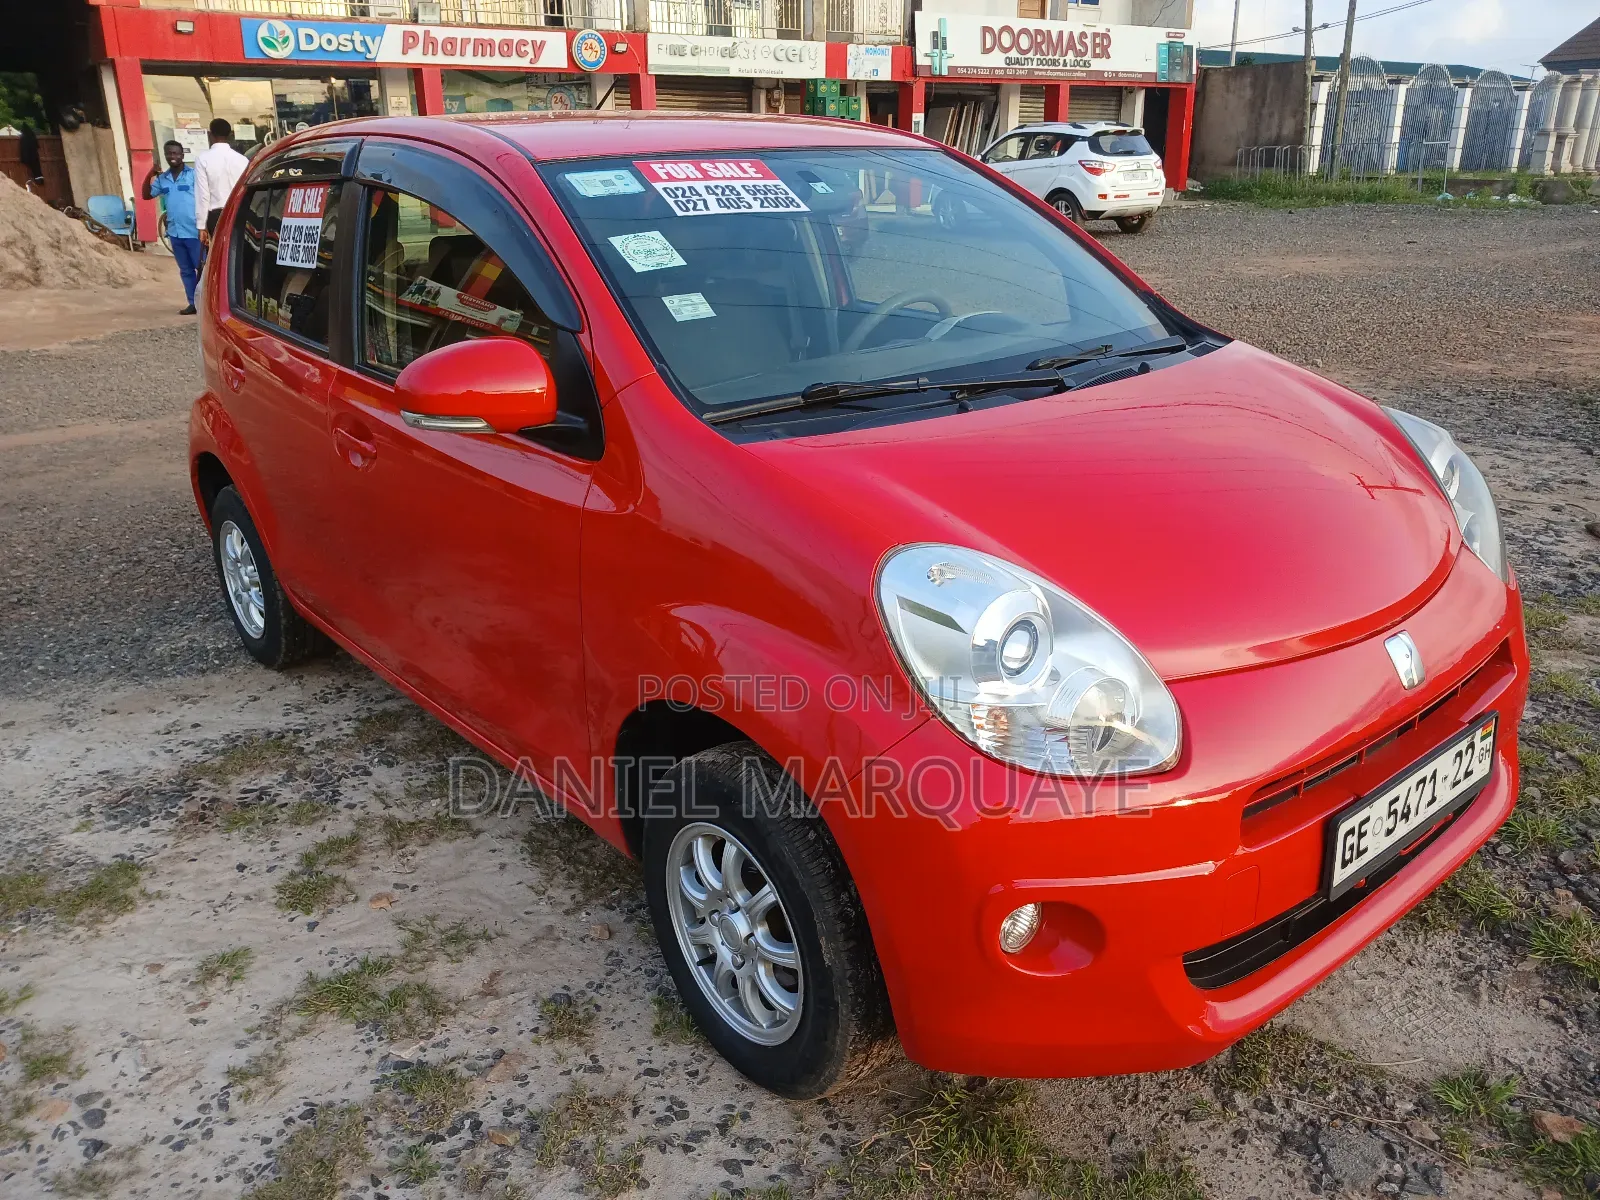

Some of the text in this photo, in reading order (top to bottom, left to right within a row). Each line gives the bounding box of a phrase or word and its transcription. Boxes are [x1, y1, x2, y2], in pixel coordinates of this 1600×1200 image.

[297, 27, 546, 64] Dosty Pharmacy
[657, 43, 687, 57] FINE
[1004, 56, 1091, 68] QUALITY DOORS & LOCKS
[650, 162, 763, 180] FOR SALE
[288, 187, 323, 214] FOR SALE
[662, 184, 789, 199] 024 428 6665
[675, 196, 802, 213] 027 405 2008
[281, 224, 320, 245] 024 428 6665
[278, 244, 317, 264] 027 405 2008
[1478, 743, 1492, 764] GH
[1341, 815, 1371, 870] GE
